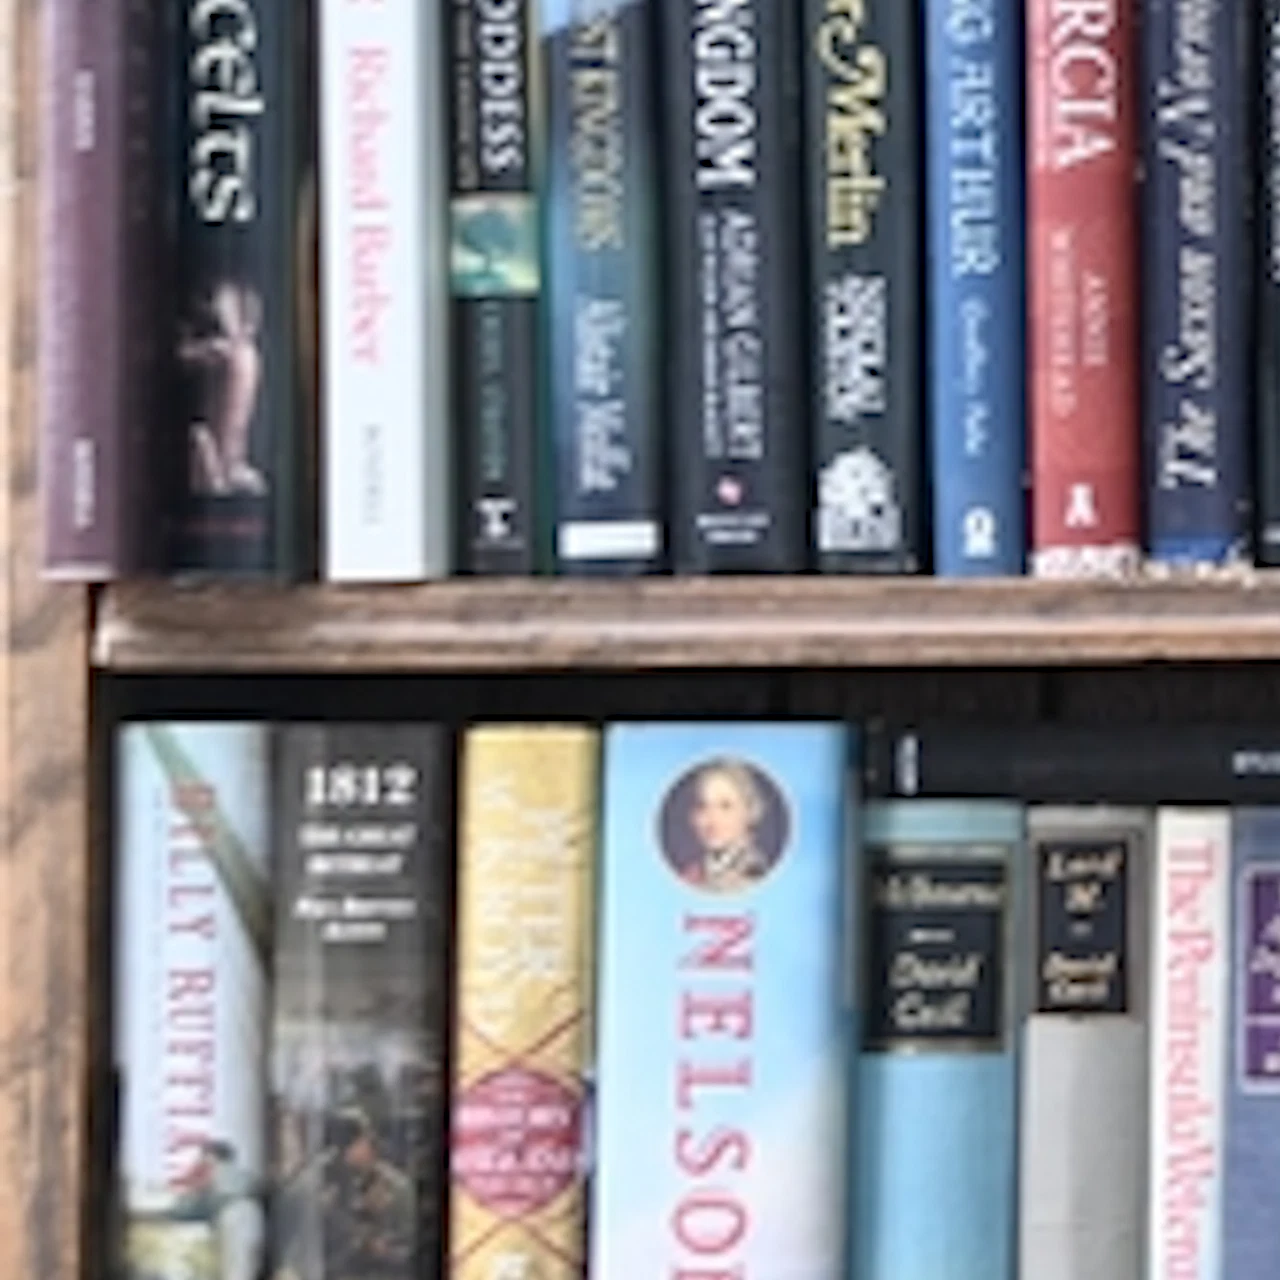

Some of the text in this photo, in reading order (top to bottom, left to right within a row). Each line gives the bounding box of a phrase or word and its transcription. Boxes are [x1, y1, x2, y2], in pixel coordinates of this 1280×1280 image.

[347, 45, 396, 370] Richard Barber
[566, 68, 620, 252] KINGDOMS
[822, 23, 886, 248] Merlin
[948, 54, 1000, 280] ARTHUR
[1162, 158, 1222, 233] and
[576, 294, 630, 492] Alistair Moffat
[720, 211, 762, 458] ADRIAN GILBERT
[1081, 271, 1108, 368] ANNIE
[1162, 247, 1222, 382] Saxon
[1156, 401, 1222, 490] The
[303, 763, 419, 807] 1812
[1046, 848, 1122, 879] Lord
[1166, 840, 1213, 921] The
[164, 780, 219, 1194] BILLY RUFFIAN
[1166, 926, 1213, 1143] Peninsula
